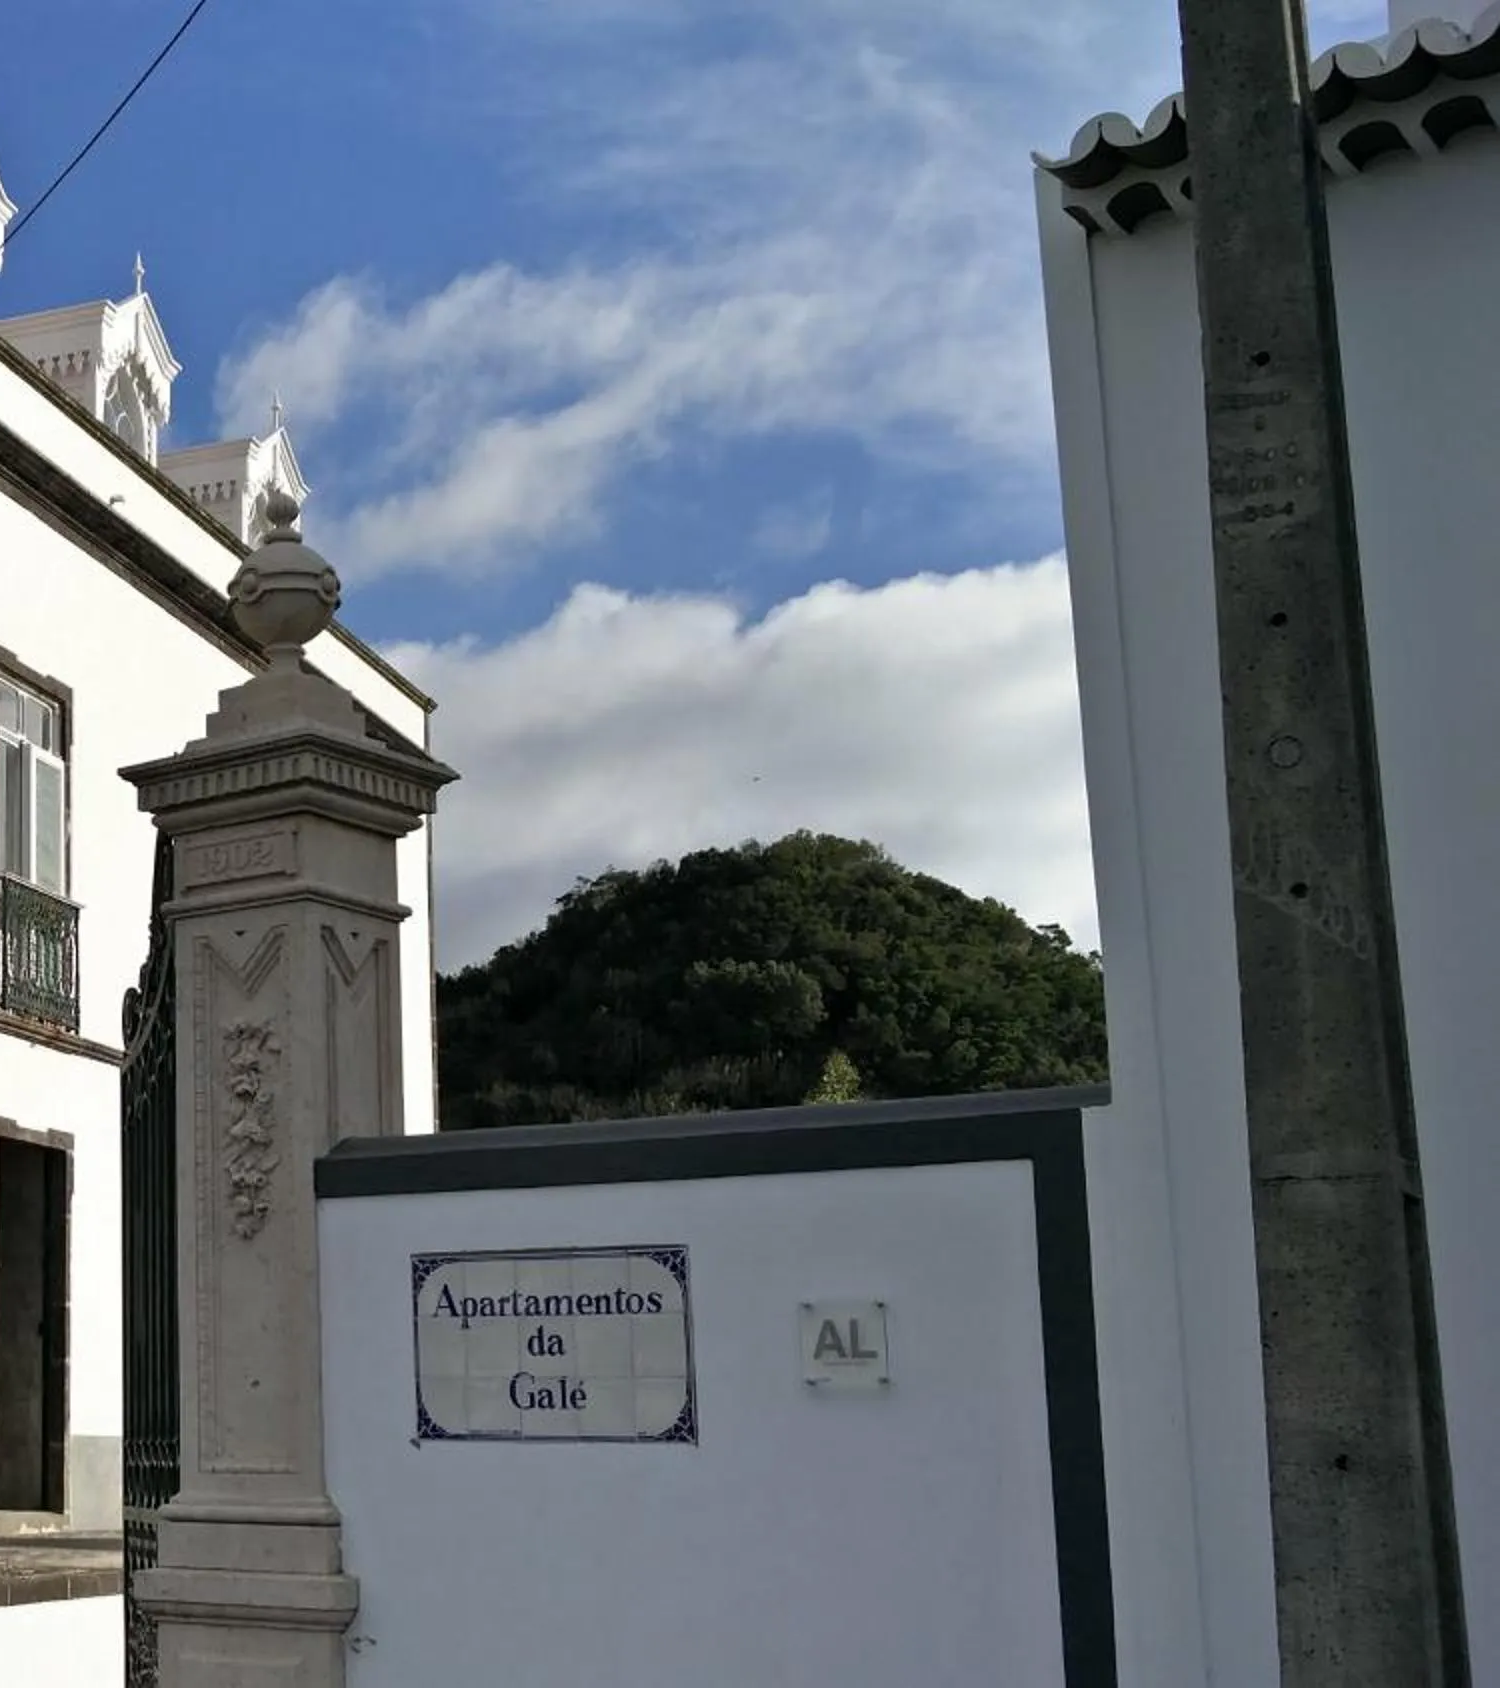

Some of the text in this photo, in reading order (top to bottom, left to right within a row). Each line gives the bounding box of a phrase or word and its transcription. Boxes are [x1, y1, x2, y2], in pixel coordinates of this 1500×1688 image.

[432, 1283, 663, 1330] Apartamentos
[526, 1325, 566, 1357] da
[812, 1318, 879, 1361] AL
[509, 1371, 588, 1411] Galé
